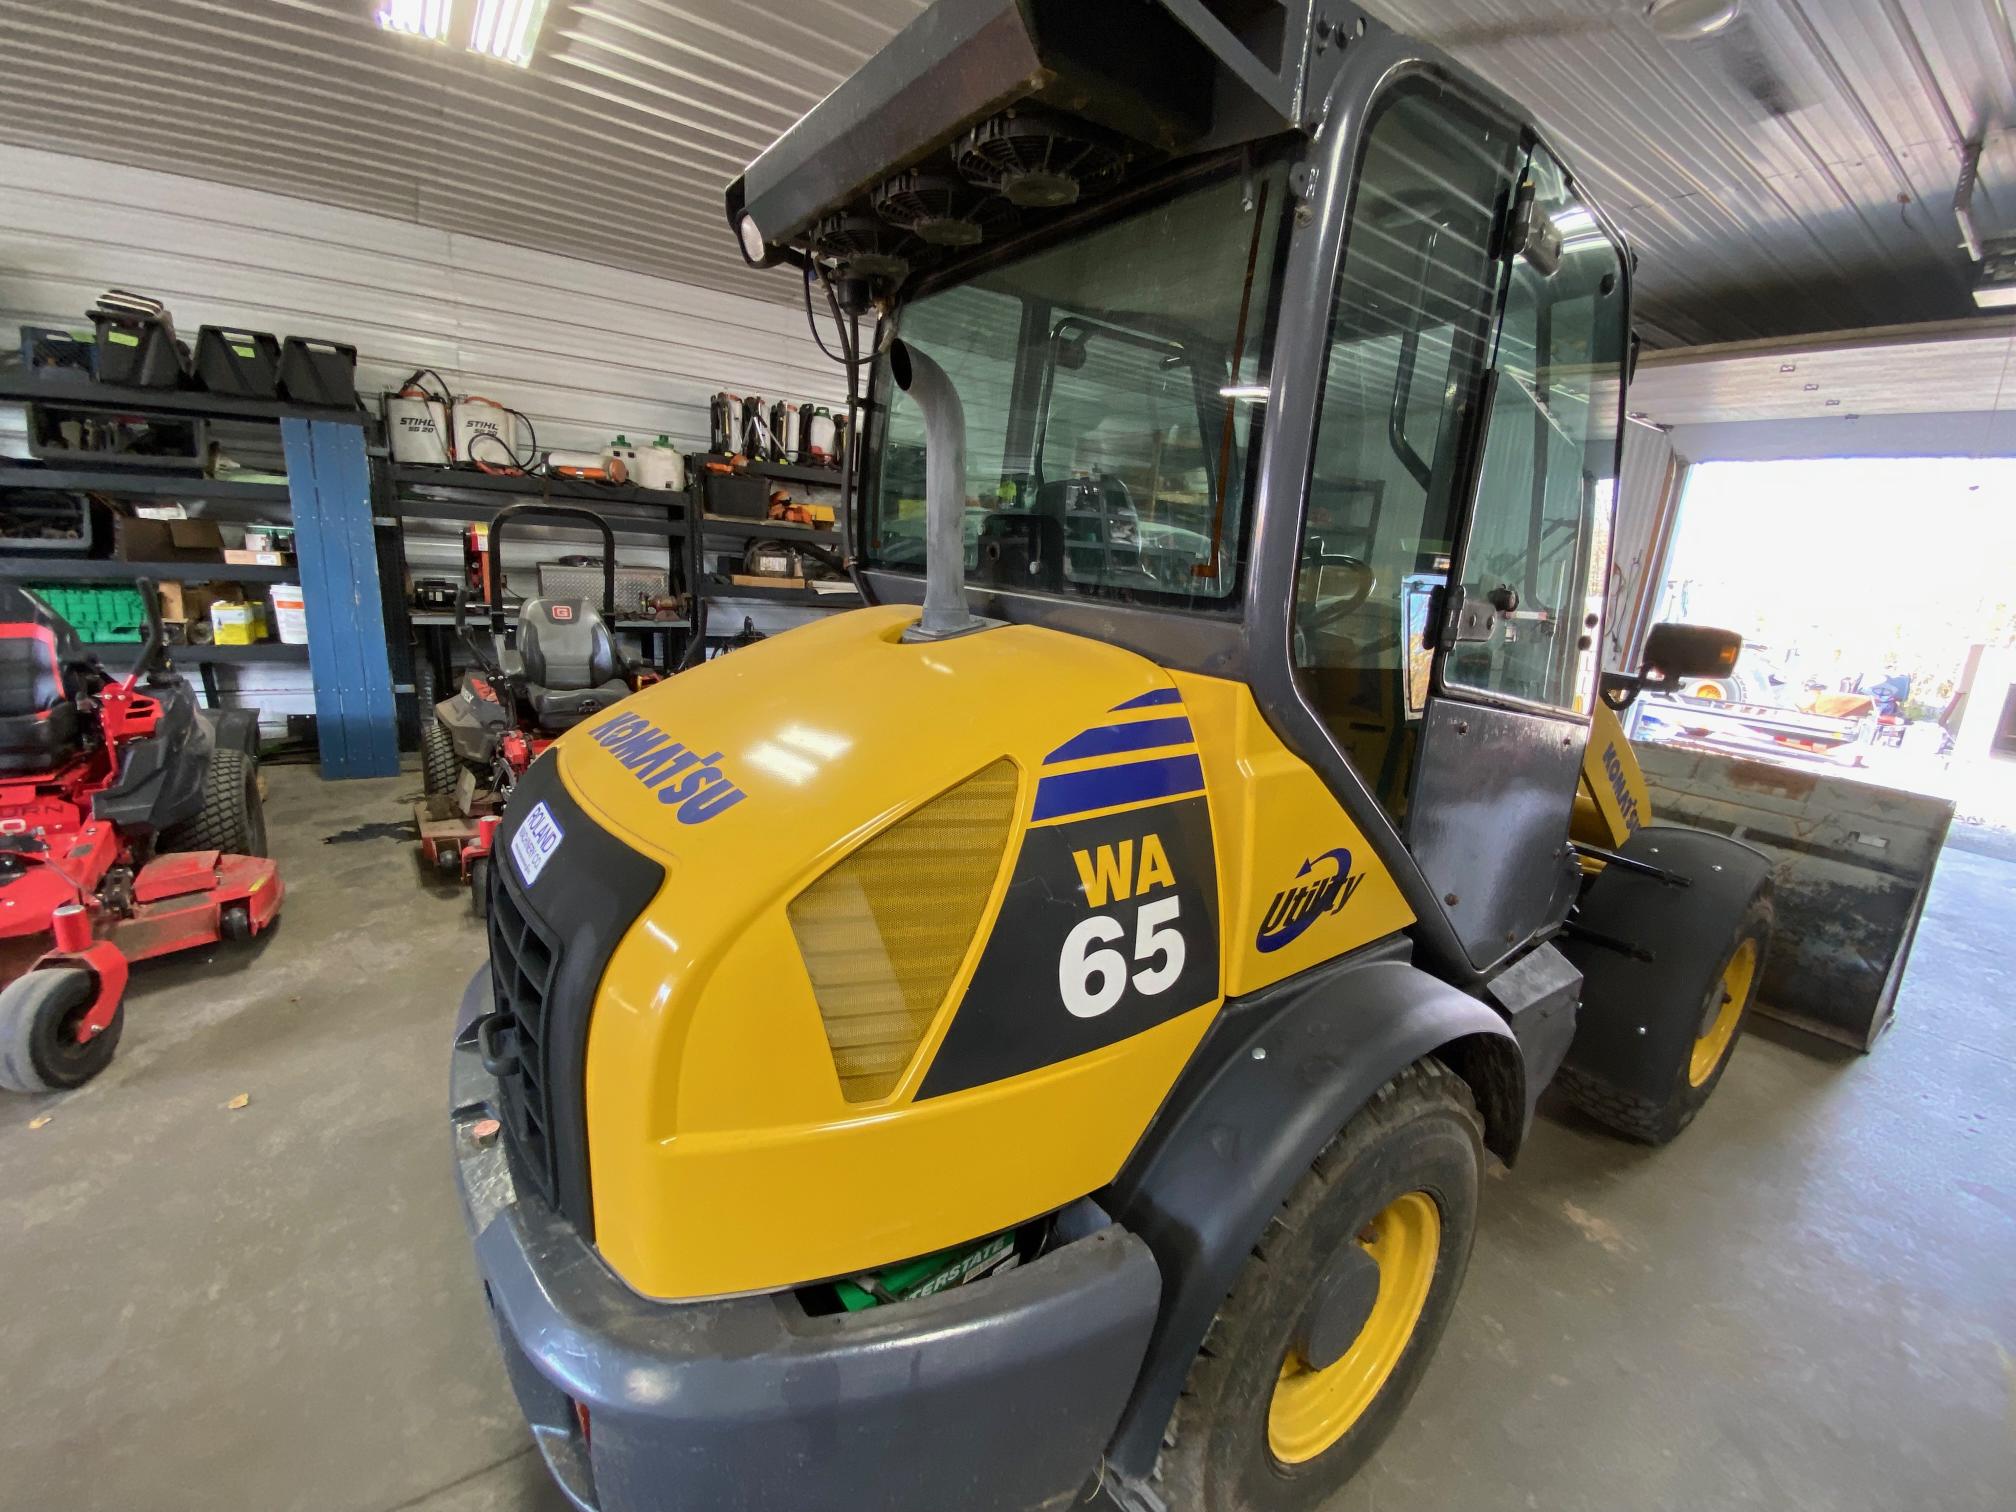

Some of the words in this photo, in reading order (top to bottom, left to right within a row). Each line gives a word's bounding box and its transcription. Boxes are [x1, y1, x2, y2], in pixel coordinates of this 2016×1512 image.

[400, 417, 435, 427] STIHL
[466, 420, 498, 431] STIHL
[587, 711, 748, 825] KOMATSU
[527, 806, 557, 854] ROLAND
[1072, 833, 1176, 909] WA
[1258, 872, 1366, 934] Utility
[1059, 895, 1185, 1018] 65
[907, 1236, 1005, 1300] TERSTATE
